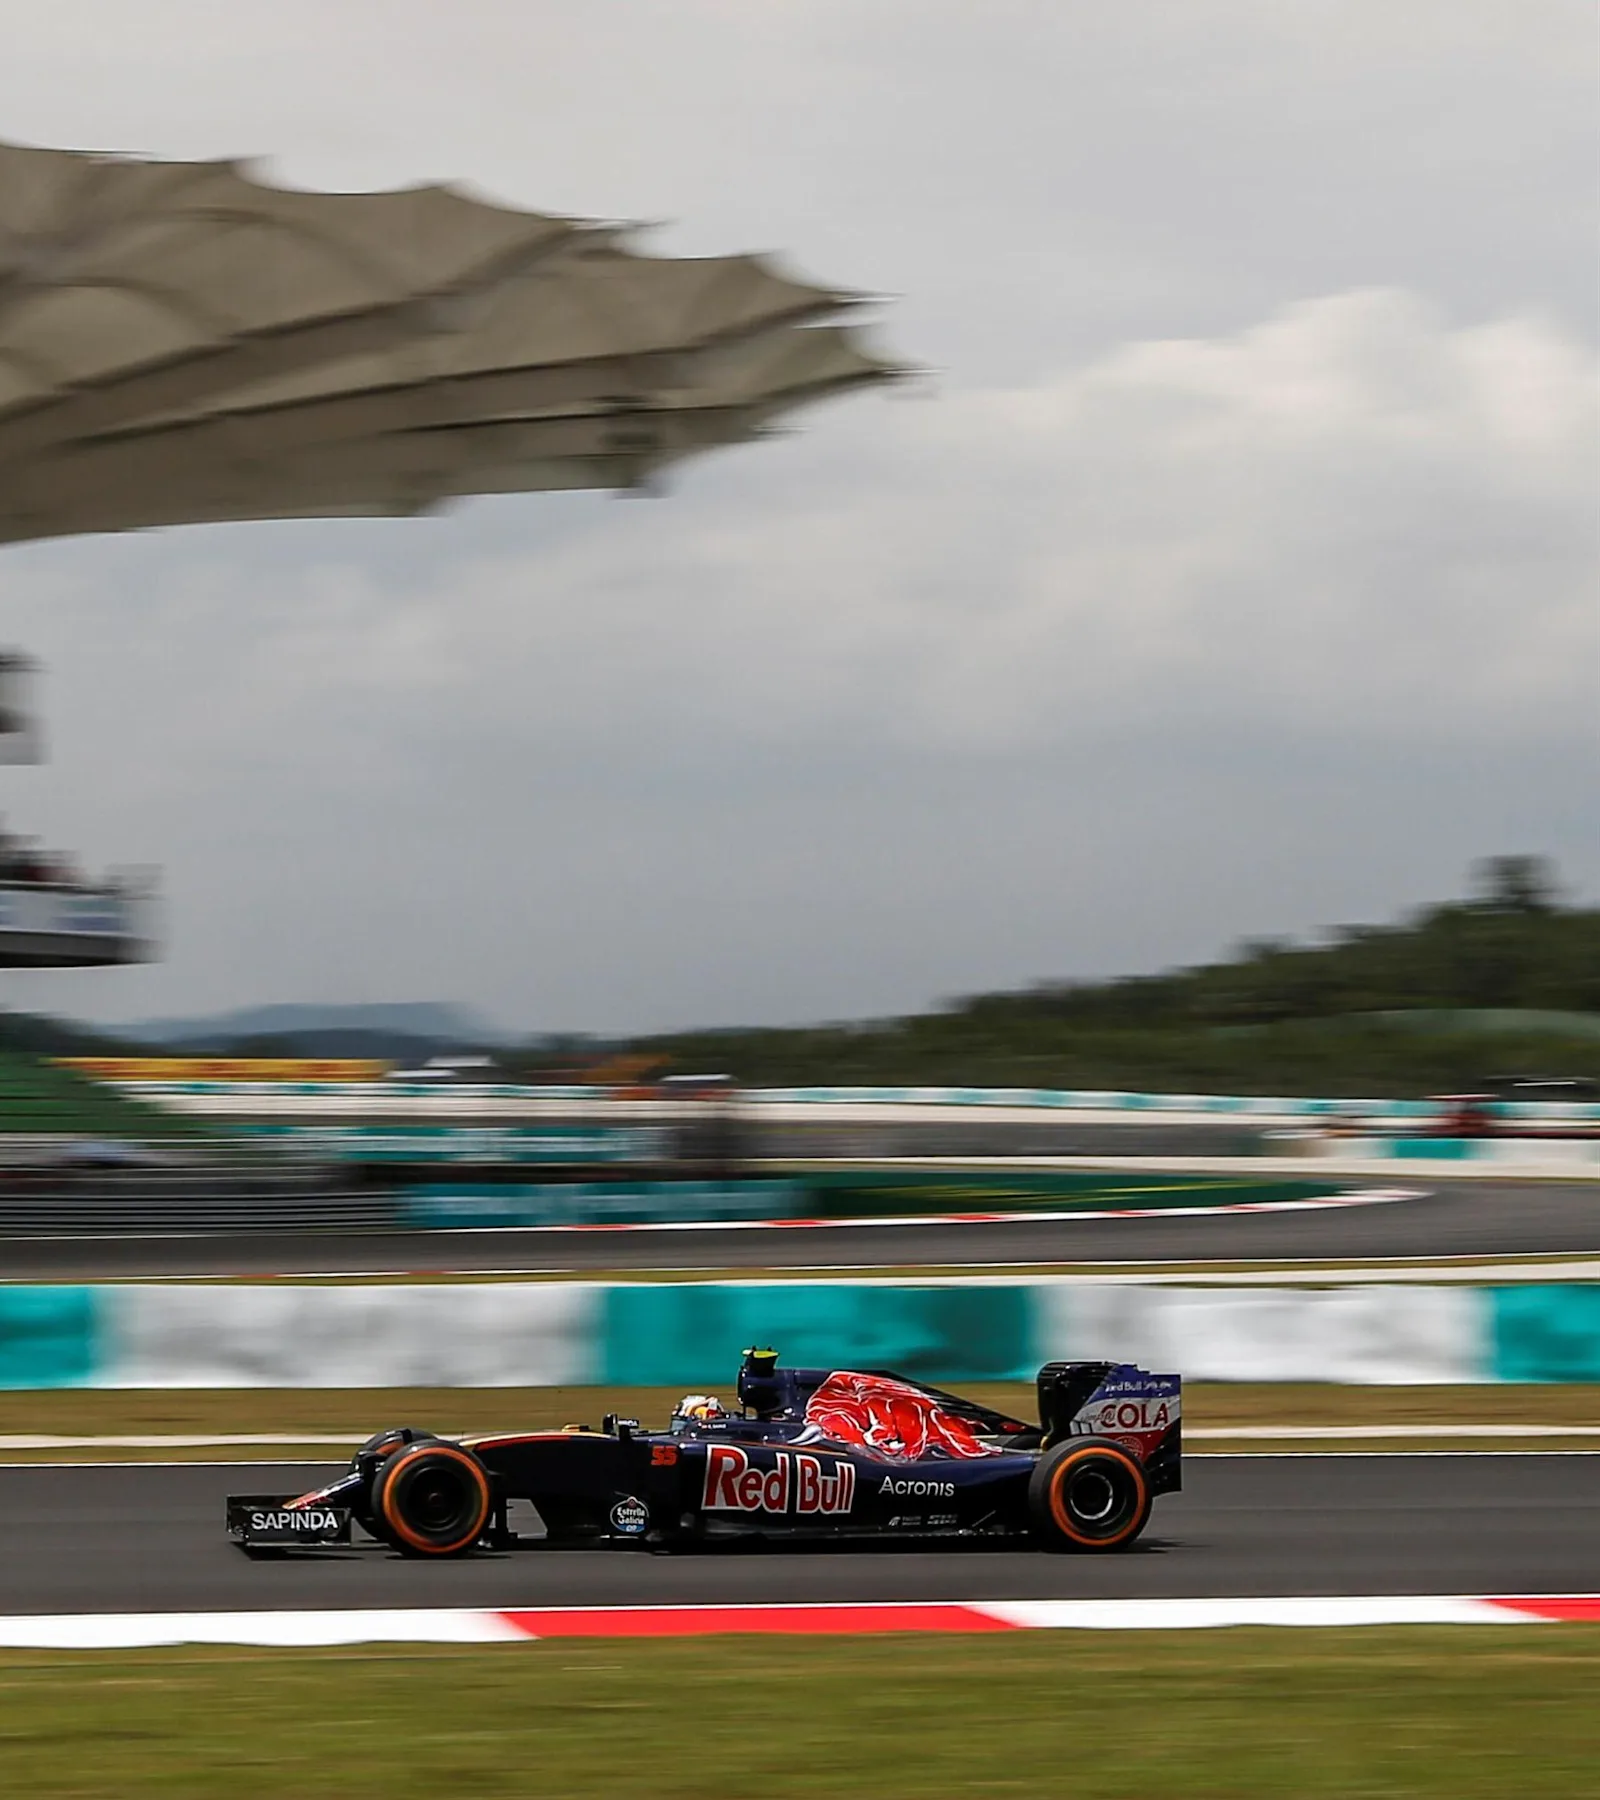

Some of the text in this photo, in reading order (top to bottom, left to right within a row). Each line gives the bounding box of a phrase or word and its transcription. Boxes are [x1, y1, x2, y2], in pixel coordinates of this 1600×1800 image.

[1100, 1403, 1169, 1429] COLA
[651, 1445, 678, 1466] 55
[701, 1444, 855, 1514] Red Bull
[878, 1475, 955, 1497] Acronis
[251, 1511, 339, 1530] SAPINDA
